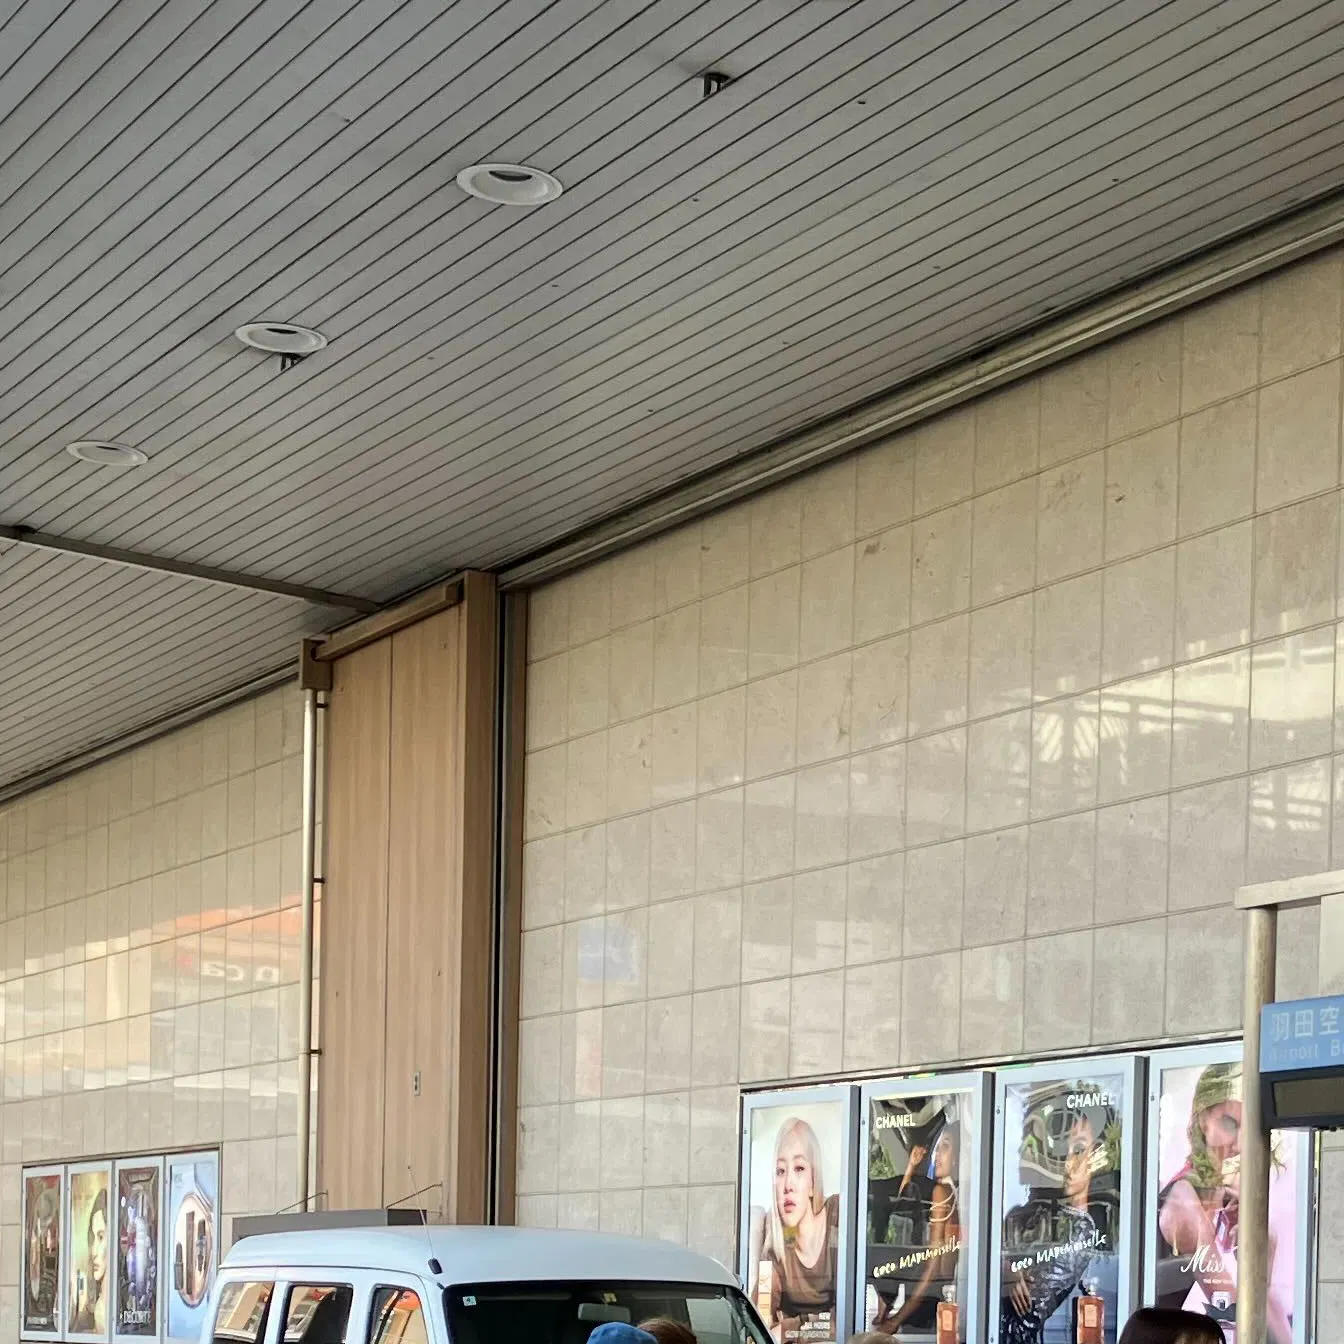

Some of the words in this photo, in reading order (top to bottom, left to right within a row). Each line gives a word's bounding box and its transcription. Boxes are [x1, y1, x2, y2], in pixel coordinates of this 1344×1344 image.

[1066, 1092, 1115, 1109] CHANEL
[875, 1113, 916, 1129] CHANEL
[1180, 1244, 1225, 1273] Miss
